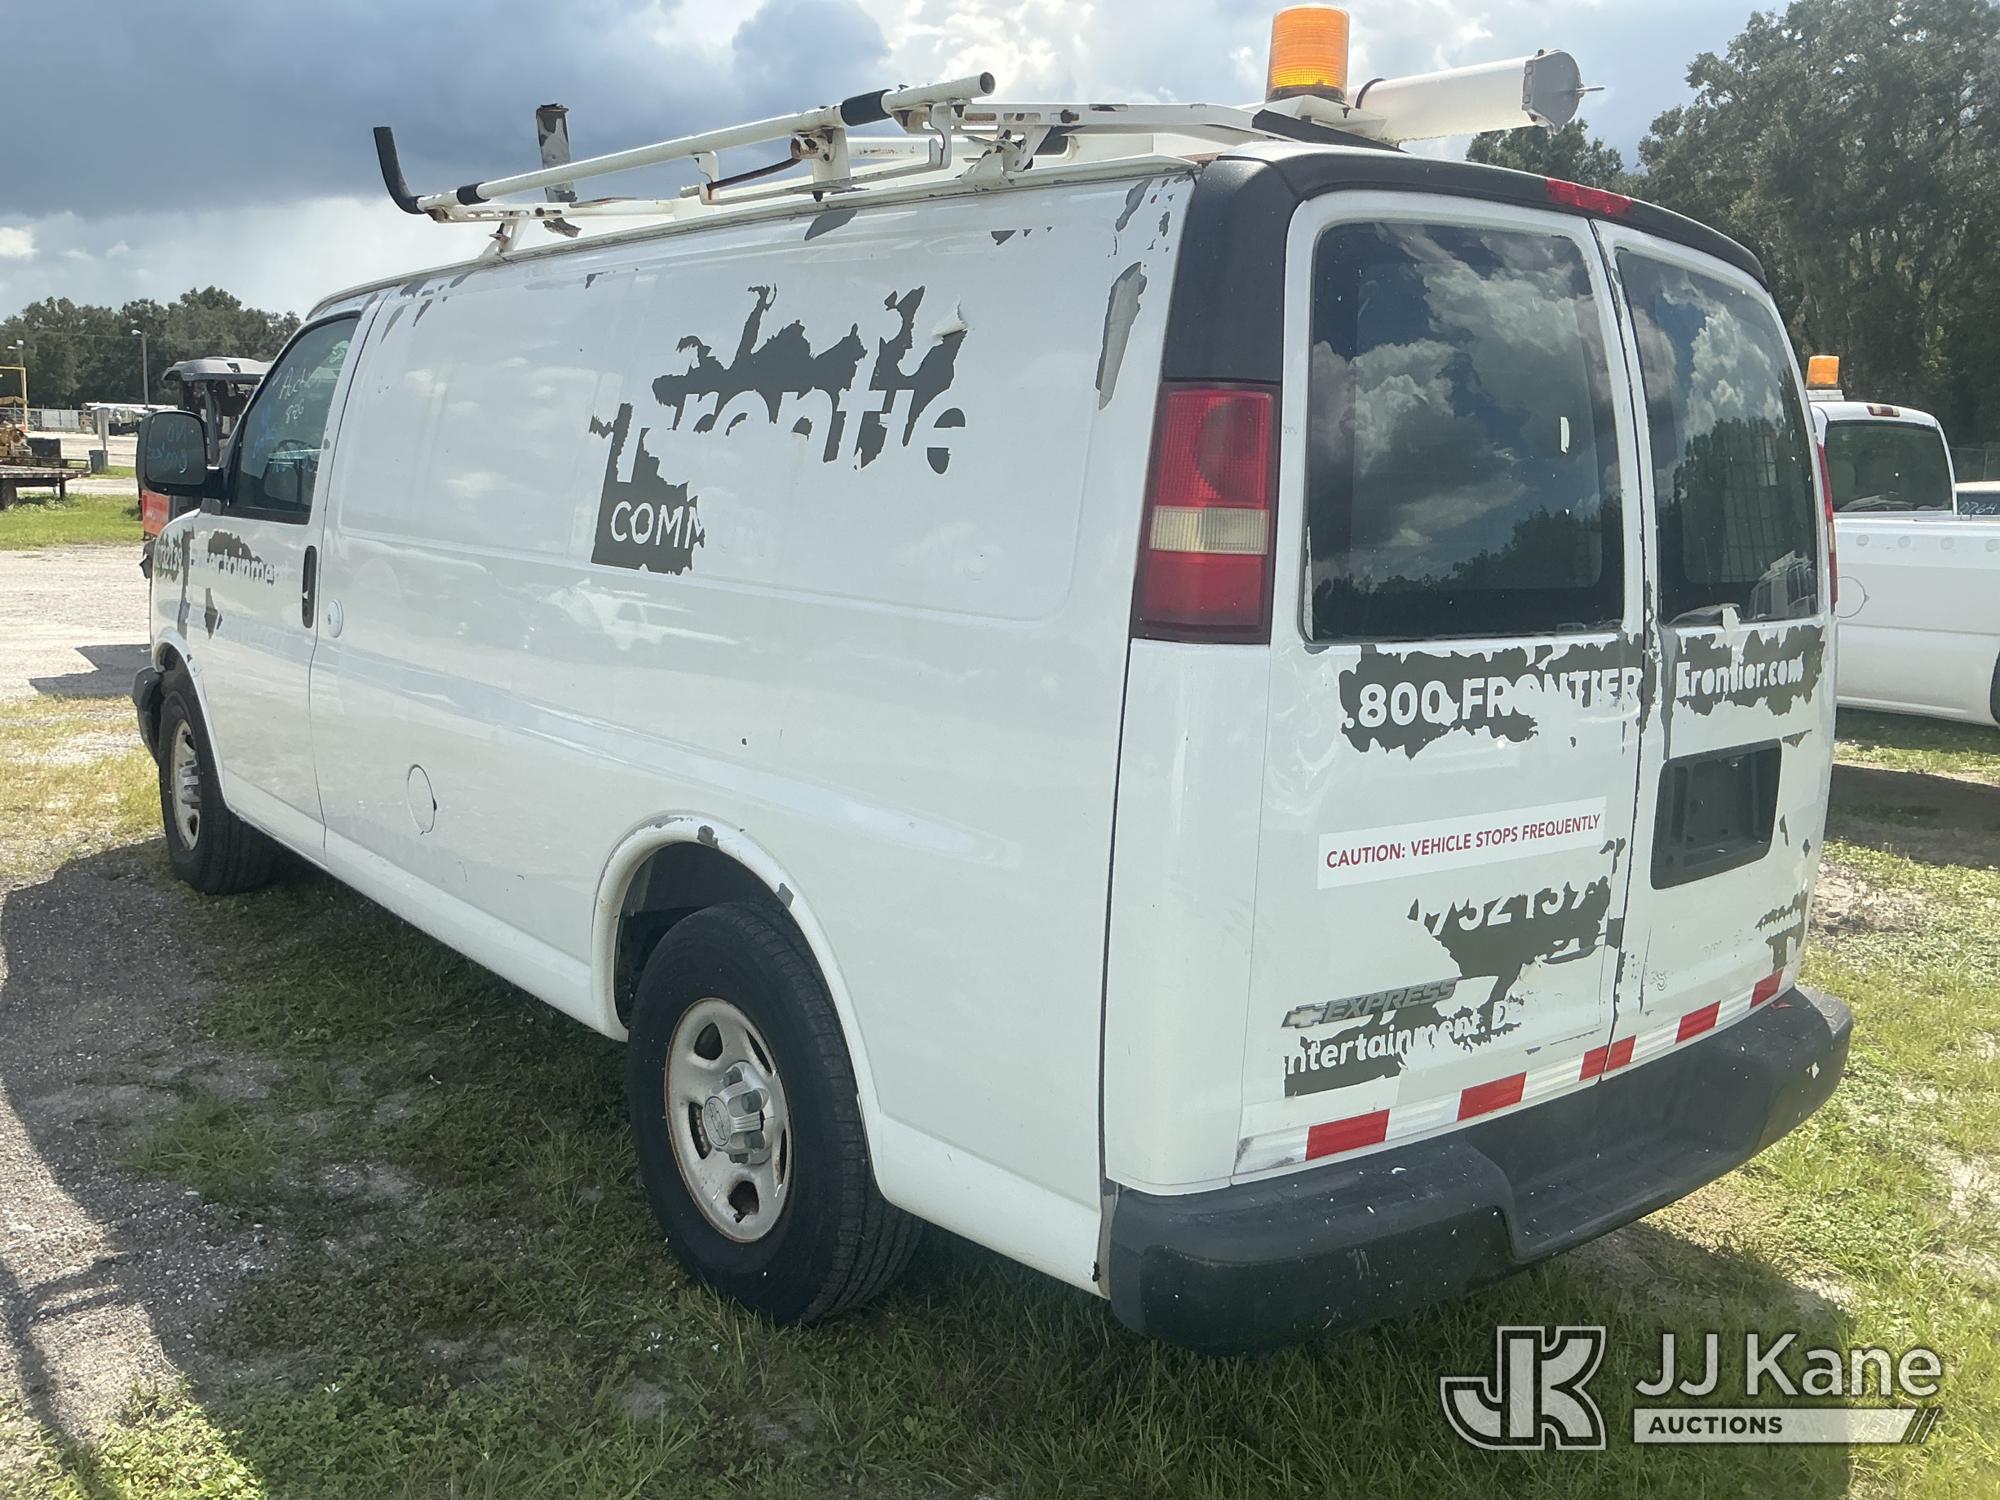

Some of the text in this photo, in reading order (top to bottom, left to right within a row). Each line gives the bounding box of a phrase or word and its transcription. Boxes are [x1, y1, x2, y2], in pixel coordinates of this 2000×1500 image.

[1326, 814, 1601, 868] CAUTION: VEHICLE STOPS FREQUENTLY
[1322, 981, 1457, 1023] EXPRESS
